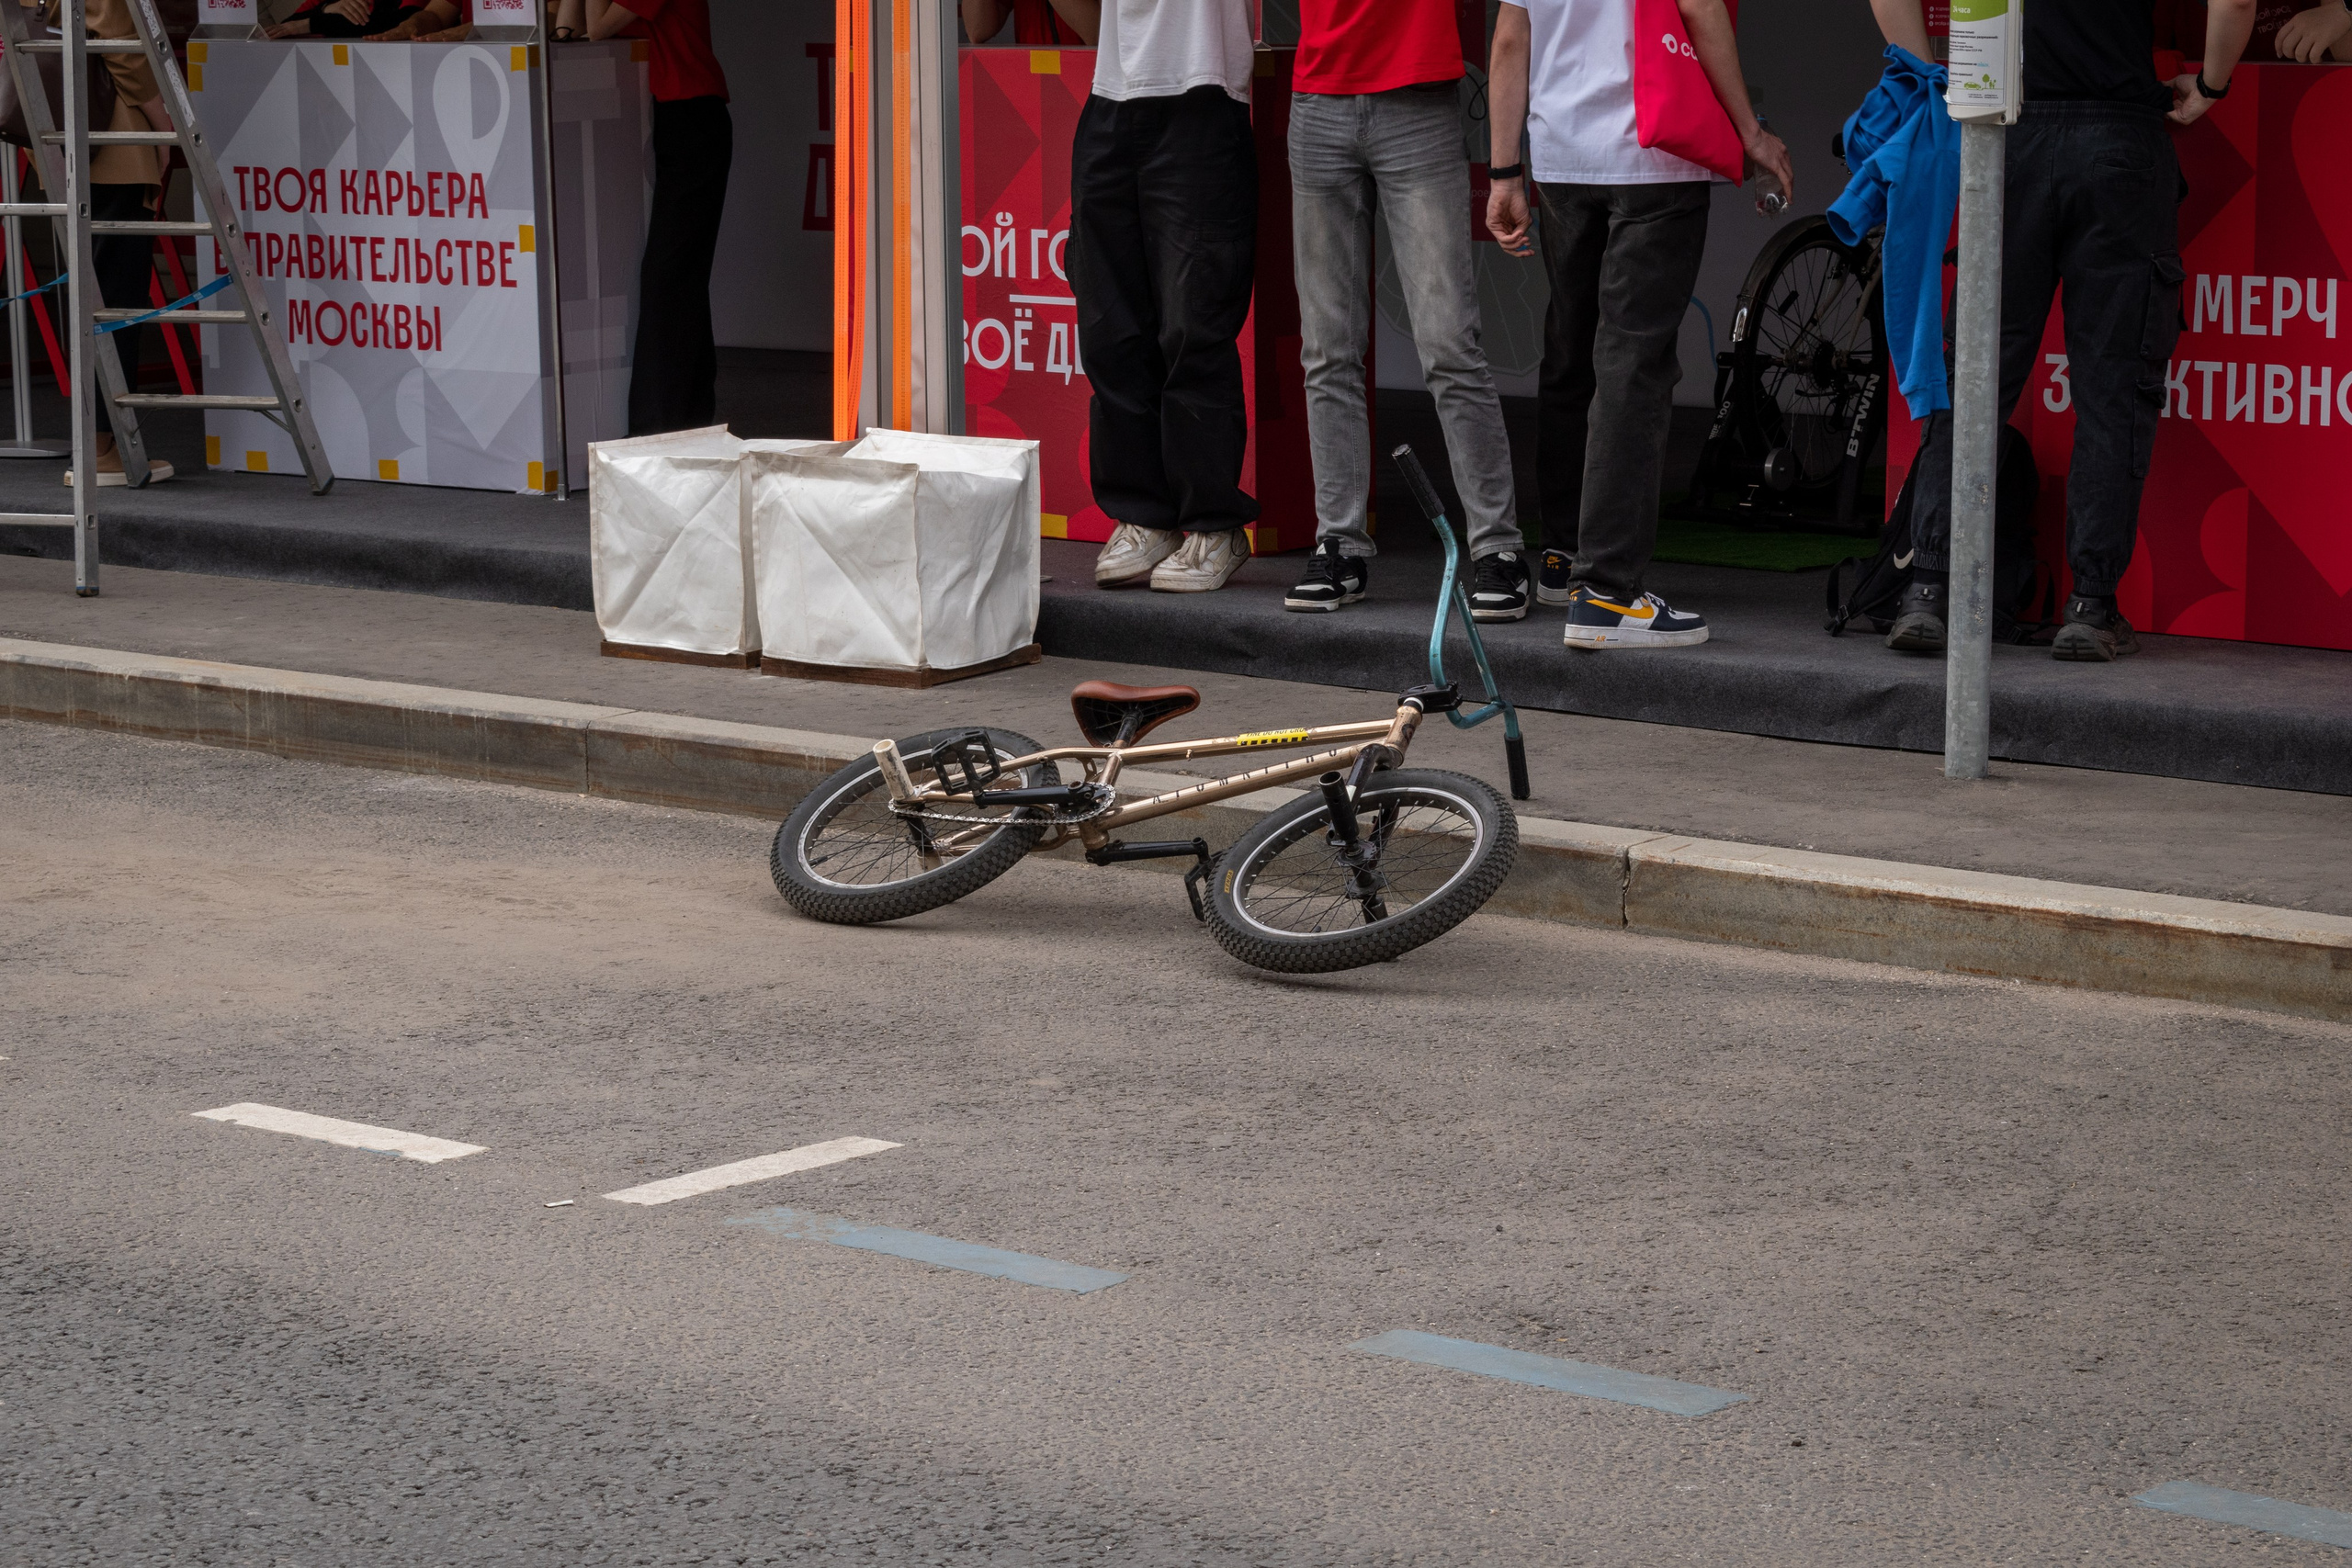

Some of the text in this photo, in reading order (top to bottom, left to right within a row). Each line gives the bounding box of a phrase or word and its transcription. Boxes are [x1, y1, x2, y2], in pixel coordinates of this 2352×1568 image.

[233, 166, 489, 220] ТВОЯ КАРЬЕРА
[243, 231, 518, 288] ПРАВИТЕЛЬСТВЕ
[962, 212, 1070, 282] ОЙ ГО
[288, 299, 442, 351] МОСКВЫ
[2193, 274, 2337, 339] МЕРЧ
